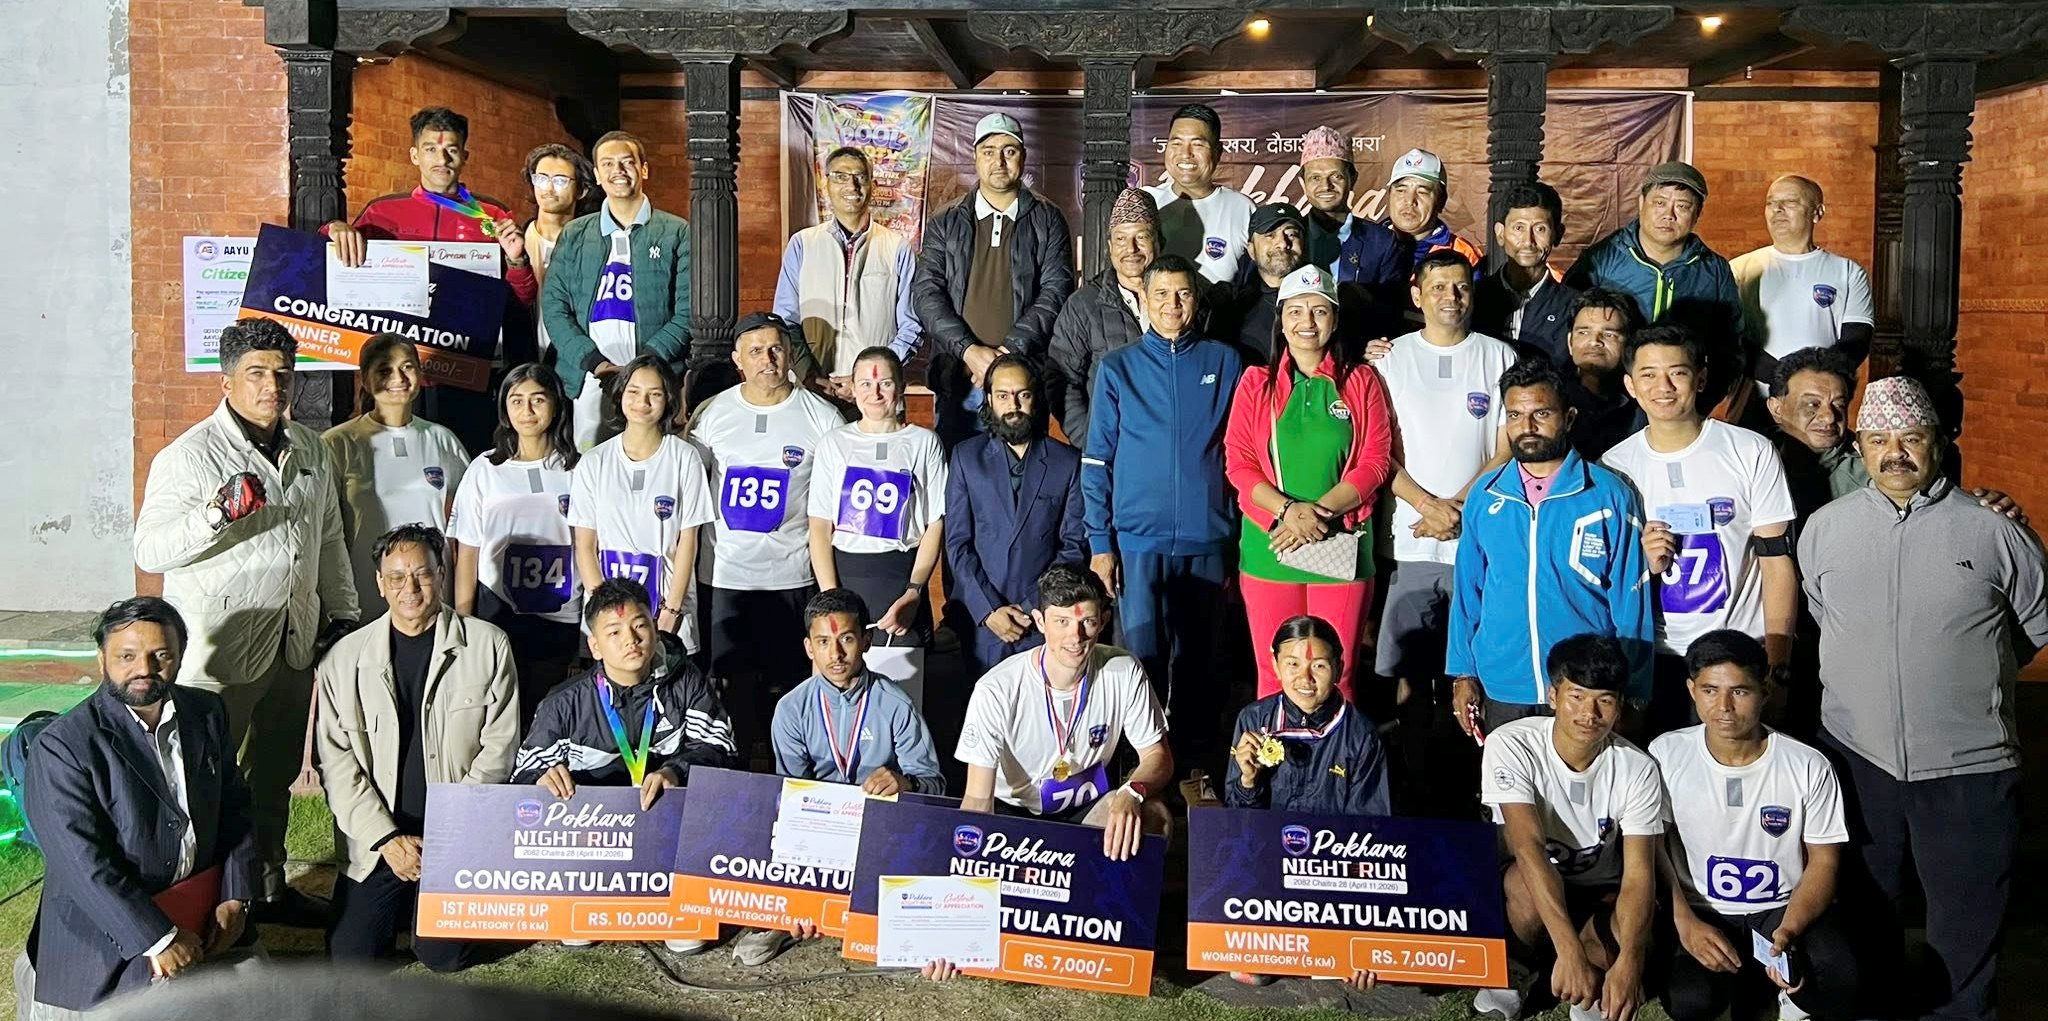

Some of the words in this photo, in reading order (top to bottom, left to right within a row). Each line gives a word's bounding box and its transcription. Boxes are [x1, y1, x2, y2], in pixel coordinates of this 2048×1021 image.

[224, 246, 249, 255] AAYU
[471, 249, 492, 261] Park
[202, 267, 248, 280] Citize
[273, 295, 470, 351] CONGRATULATION
[334, 346, 352, 359] KM)
[728, 476, 781, 510] 135
[850, 478, 899, 515] 69
[510, 557, 566, 589] 134
[1052, 781, 1099, 814] 70
[544, 802, 635, 828] Pokhara
[514, 830, 581, 847] NIGHT
[587, 831, 633, 848] RUN
[981, 832, 1076, 868] Pokhara
[1312, 829, 1407, 859] Pokhara
[950, 857, 1020, 882] NIGHT
[1024, 867, 1072, 888] RUN
[1283, 857, 1352, 877] NIGHT
[1359, 861, 1407, 880] RUN
[1312, 879, 1337, 888] Chaitra
[1349, 880, 1367, 890] (April
[1711, 862, 1775, 899] 62
[442, 901, 464, 915] 1ST
[468, 901, 526, 917] RUNNER
[529, 903, 549, 917] UP
[708, 887, 788, 913] WINNER
[588, 912, 611, 926] RS.
[616, 911, 685, 929] 10,000/-
[679, 903, 711, 916] UNDER
[725, 908, 779, 924] CATEGORY
[1000, 906, 1123, 943] TULATION
[1223, 897, 1468, 932] CONGRATULATION
[436, 920, 462, 929] OPEN
[463, 920, 515, 930] CATEGORY
[529, 921, 549, 932] KM)
[850, 942, 879, 955] FORE
[1224, 930, 1310, 953] WINNER
[1023, 953, 1048, 969] RS.
[1052, 956, 1113, 979] 7,000/-
[1201, 951, 1242, 962] WOMEN
[1243, 953, 1299, 966] CATEGORY
[1301, 954, 1313, 968] (5
[1314, 956, 1336, 970] KM)
[1371, 949, 1398, 966] RS.
[1401, 949, 1466, 972] 7,000/-
